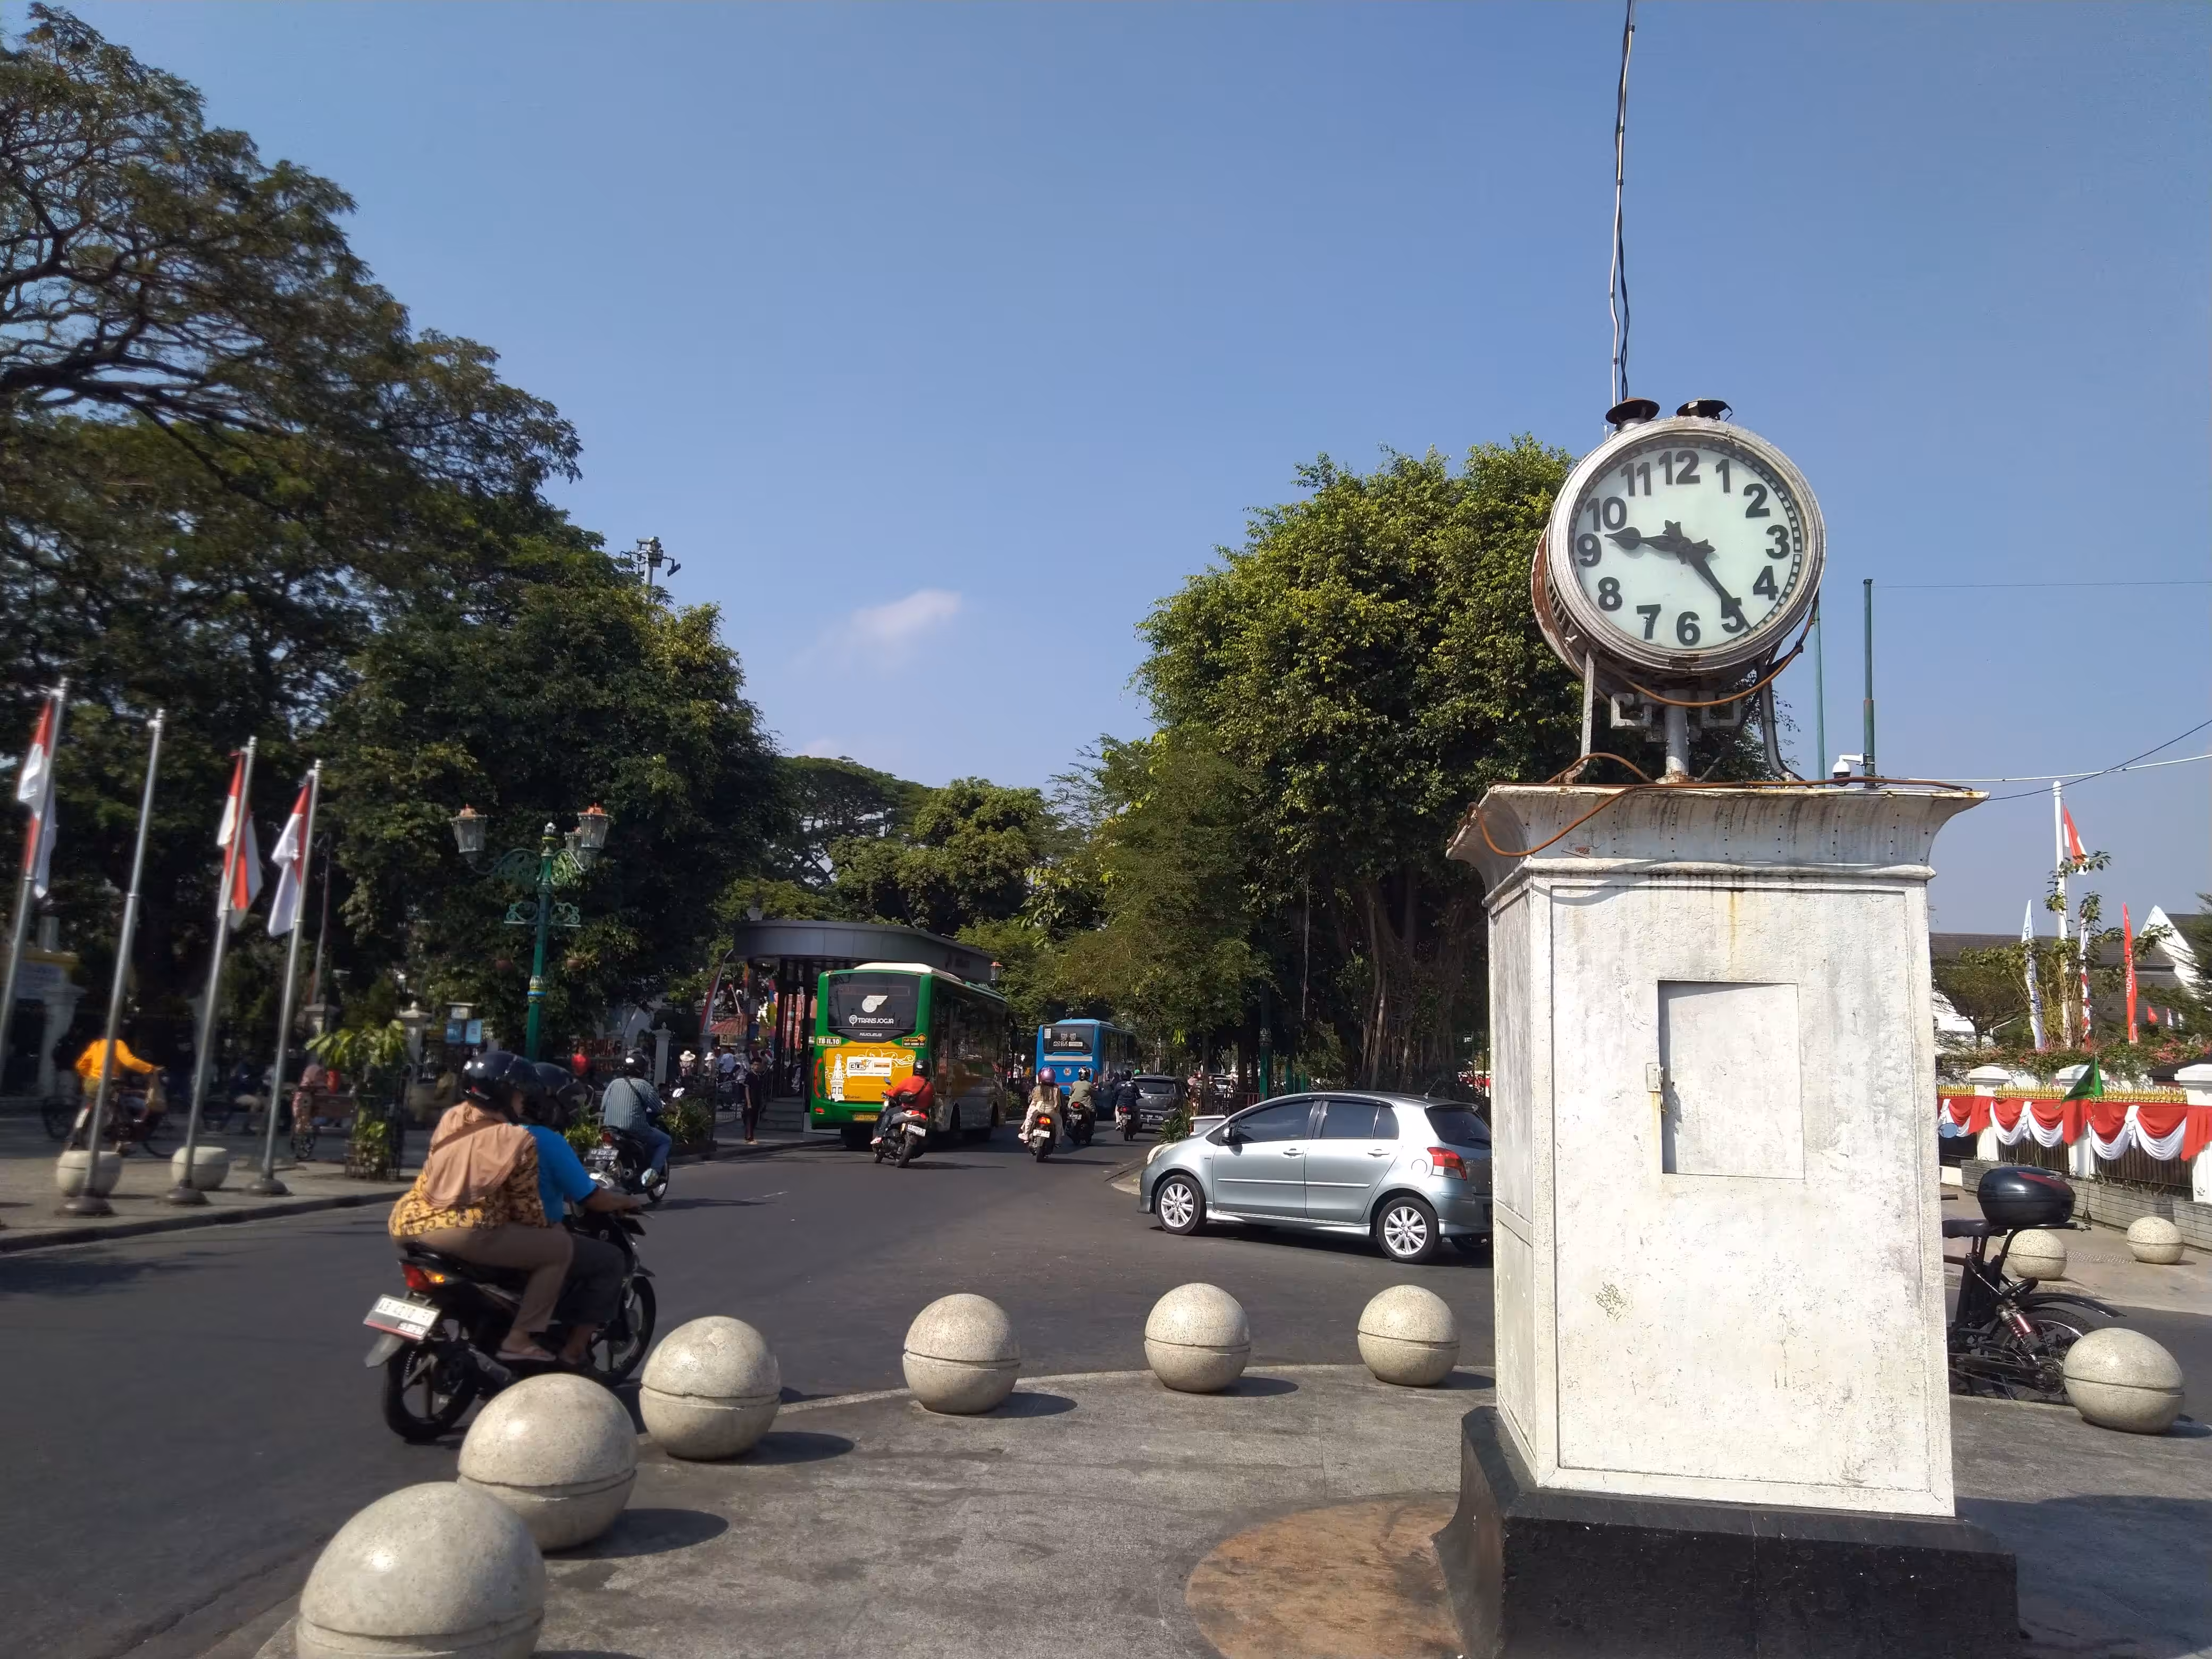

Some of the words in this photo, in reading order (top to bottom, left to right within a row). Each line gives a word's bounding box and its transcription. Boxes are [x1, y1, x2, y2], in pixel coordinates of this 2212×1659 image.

[1621, 462, 1652, 497] 11
[1658, 450, 1700, 485] 12
[1715, 459, 1731, 493] 1
[1586, 496, 1627, 532] 10
[1744, 483, 1770, 518] 2
[1577, 533, 1602, 567] 9
[1765, 525, 1790, 559] 3
[1598, 577, 1622, 611] 8
[1753, 566, 1778, 600] 4
[1636, 604, 1661, 640] 7
[1676, 611, 1700, 646] 6
